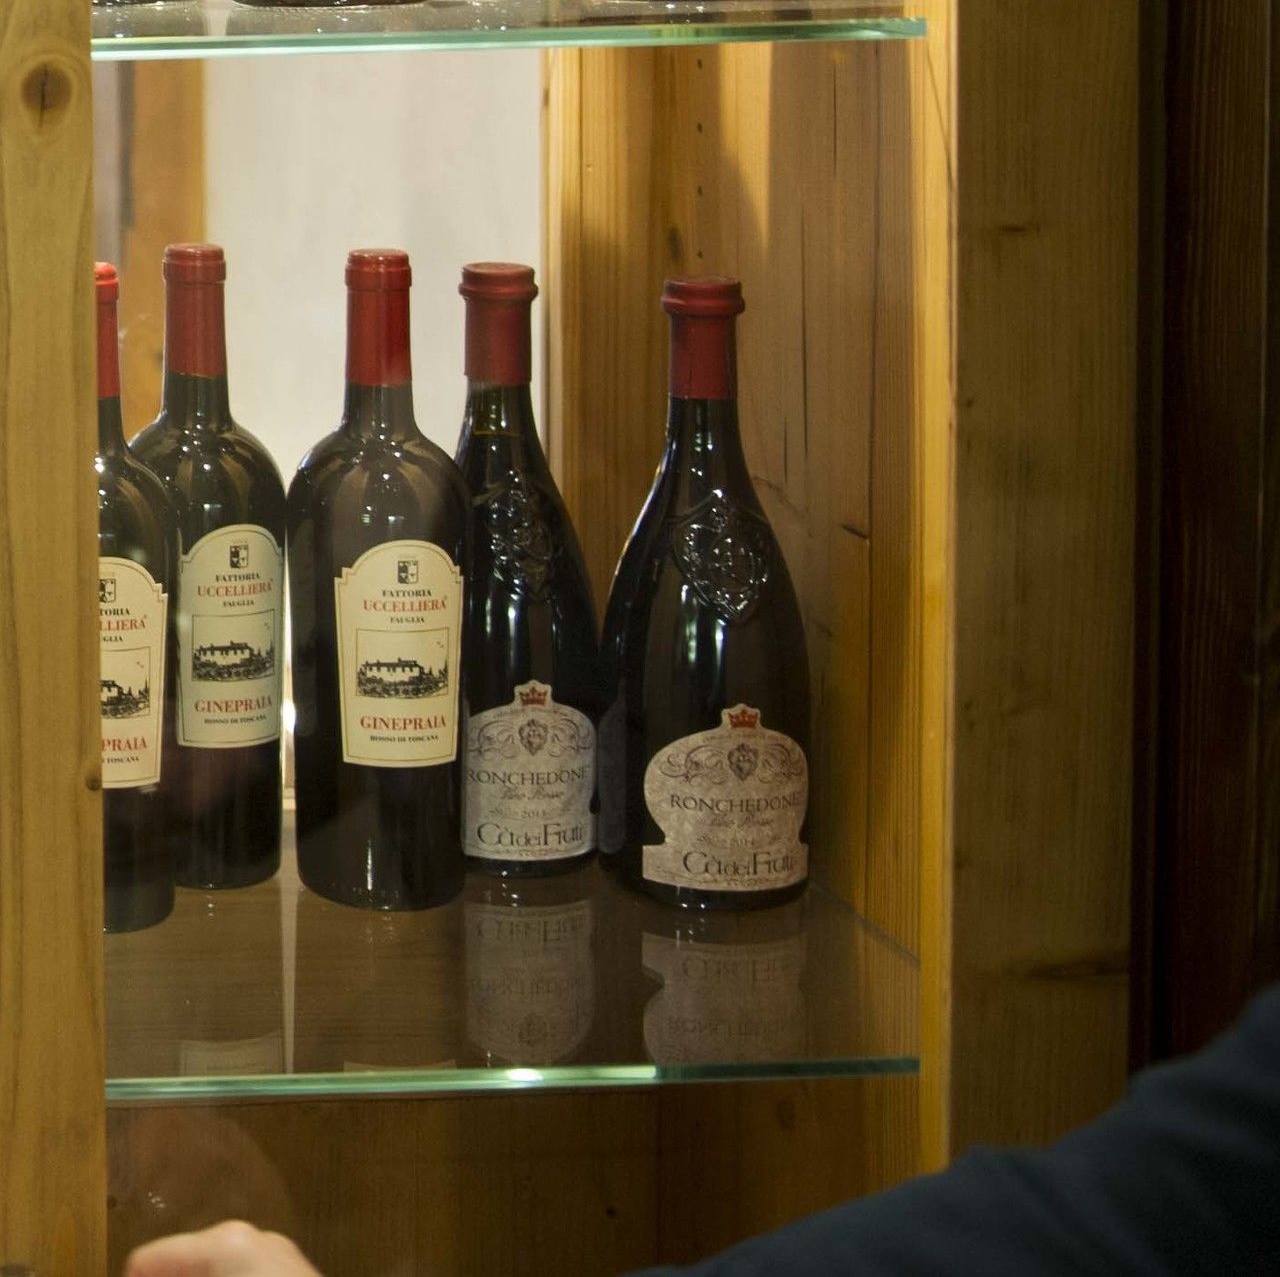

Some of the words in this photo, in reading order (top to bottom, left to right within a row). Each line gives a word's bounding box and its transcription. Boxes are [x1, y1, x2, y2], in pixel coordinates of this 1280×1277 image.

[215, 573, 260, 582] FATTORIA
[197, 581, 272, 597] UCCELLIERA
[382, 589, 432, 598] FATTORIA
[363, 598, 446, 613] UCCELLIERA
[193, 695, 272, 713] GINEPRAIA
[360, 714, 447, 731] GINEPRAIA
